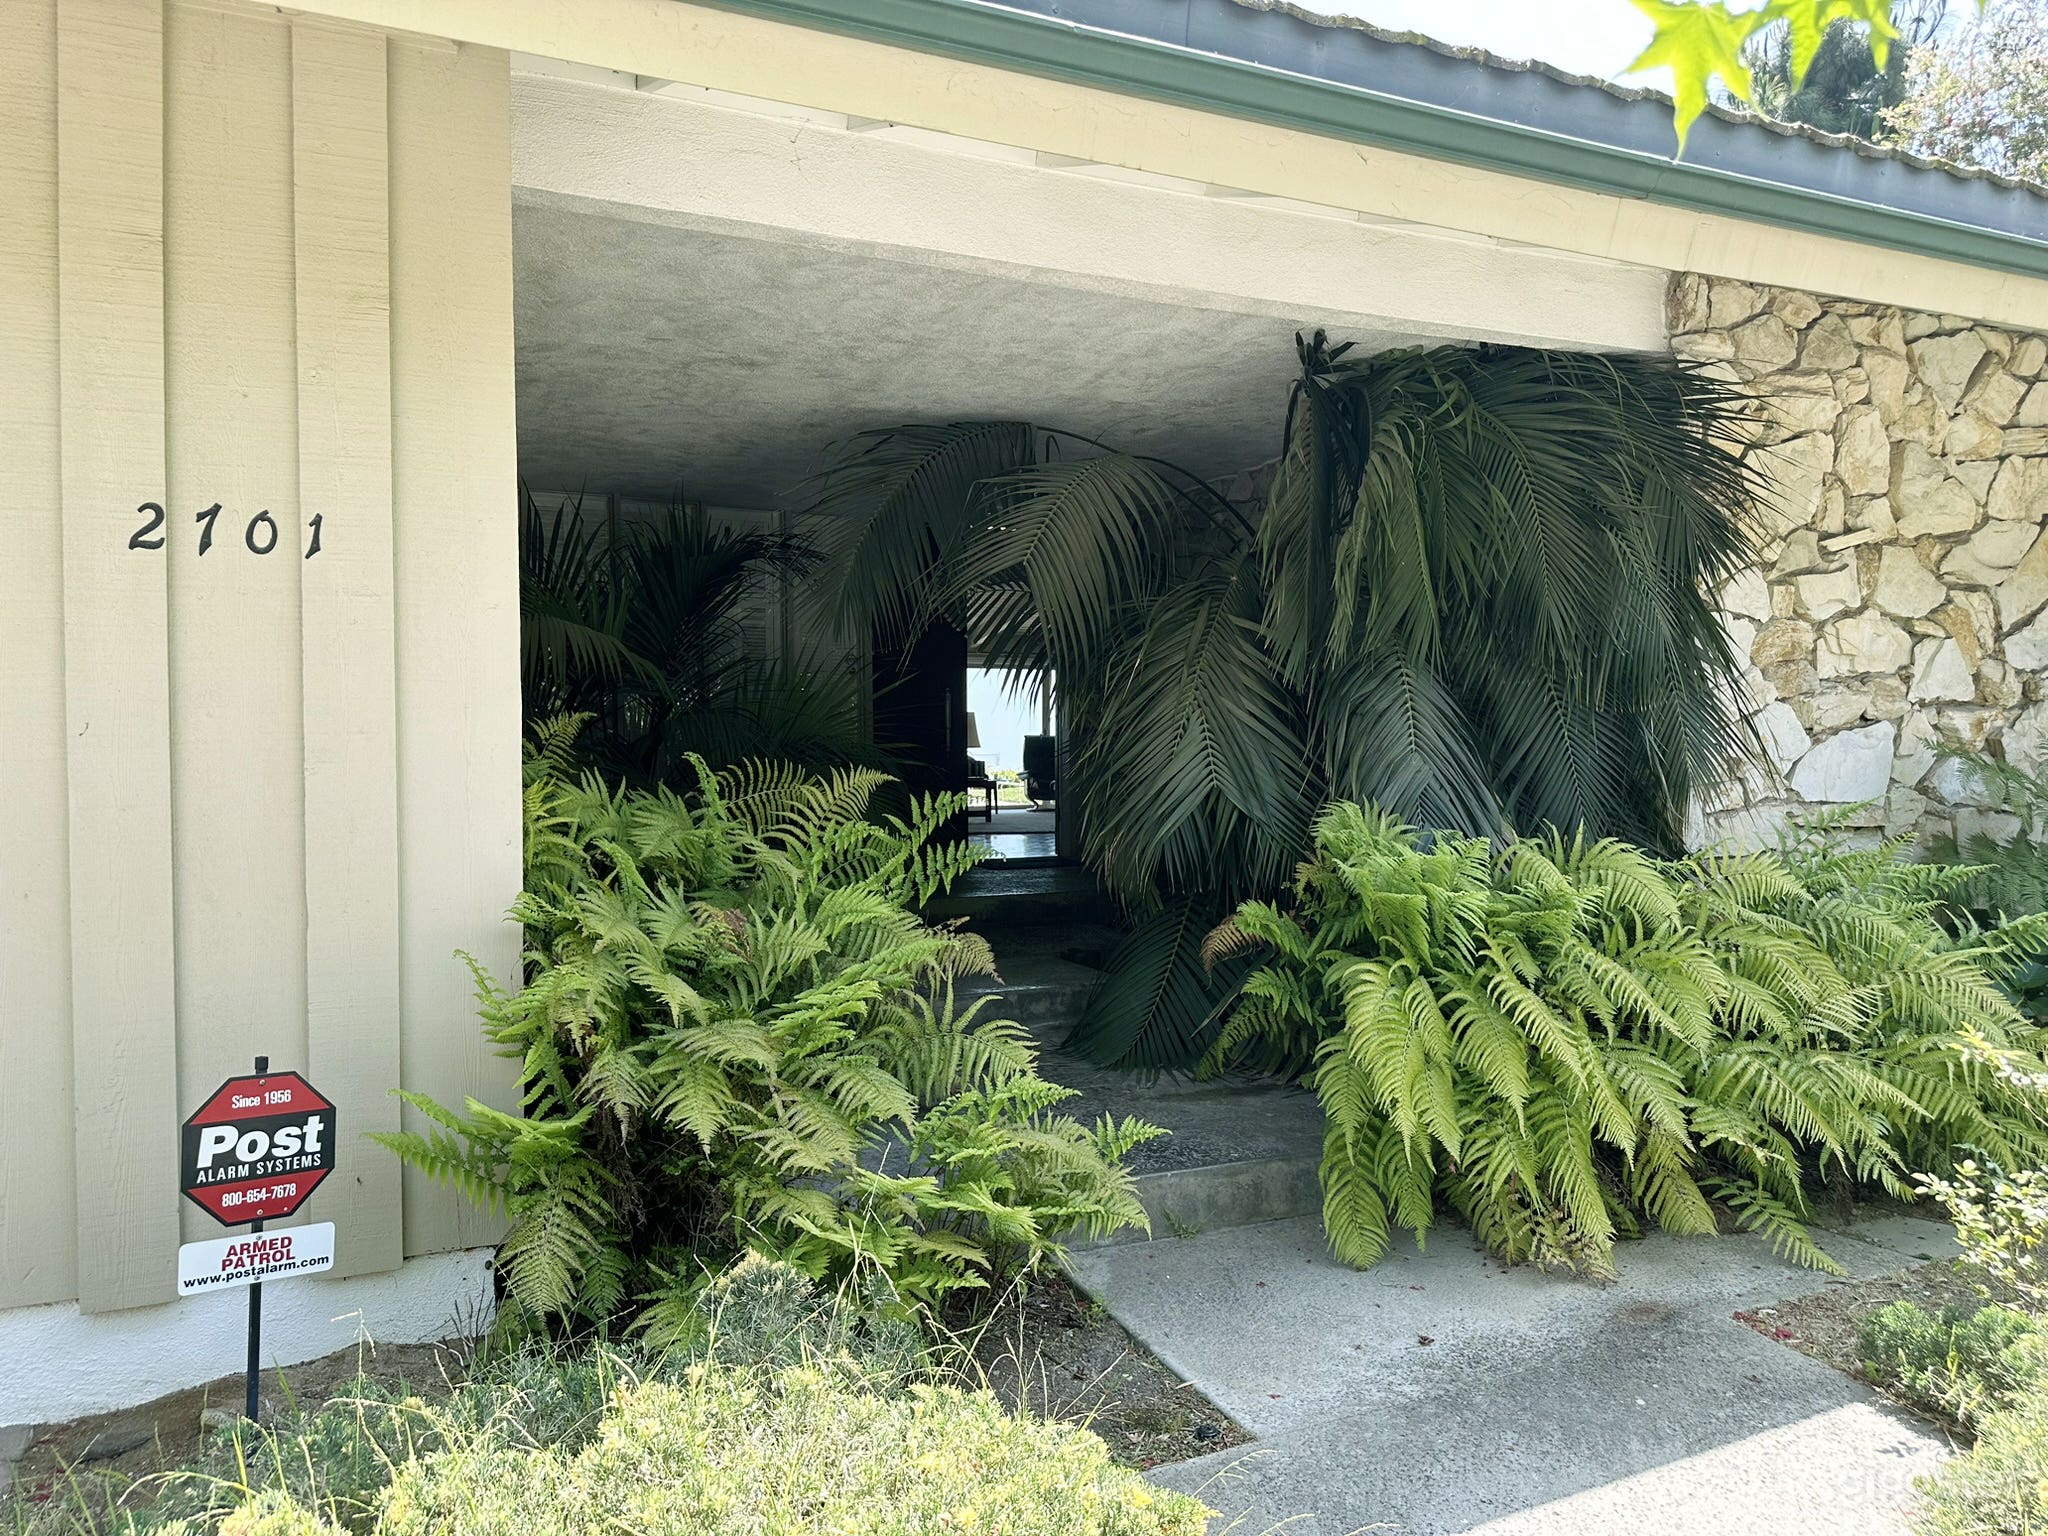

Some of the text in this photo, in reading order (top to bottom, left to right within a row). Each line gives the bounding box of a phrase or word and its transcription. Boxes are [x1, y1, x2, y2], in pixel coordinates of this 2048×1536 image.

[231, 1089, 291, 1108] Since 1956
[196, 1115, 324, 1169] Post
[196, 1153, 321, 1184] ALARM SYSTEMS
[222, 1183, 296, 1207] 800-654-7678
[226, 1236, 292, 1258] ARMED
[183, 1255, 329, 1288] www.postalarm.com
[221, 1249, 295, 1272] PATROL
